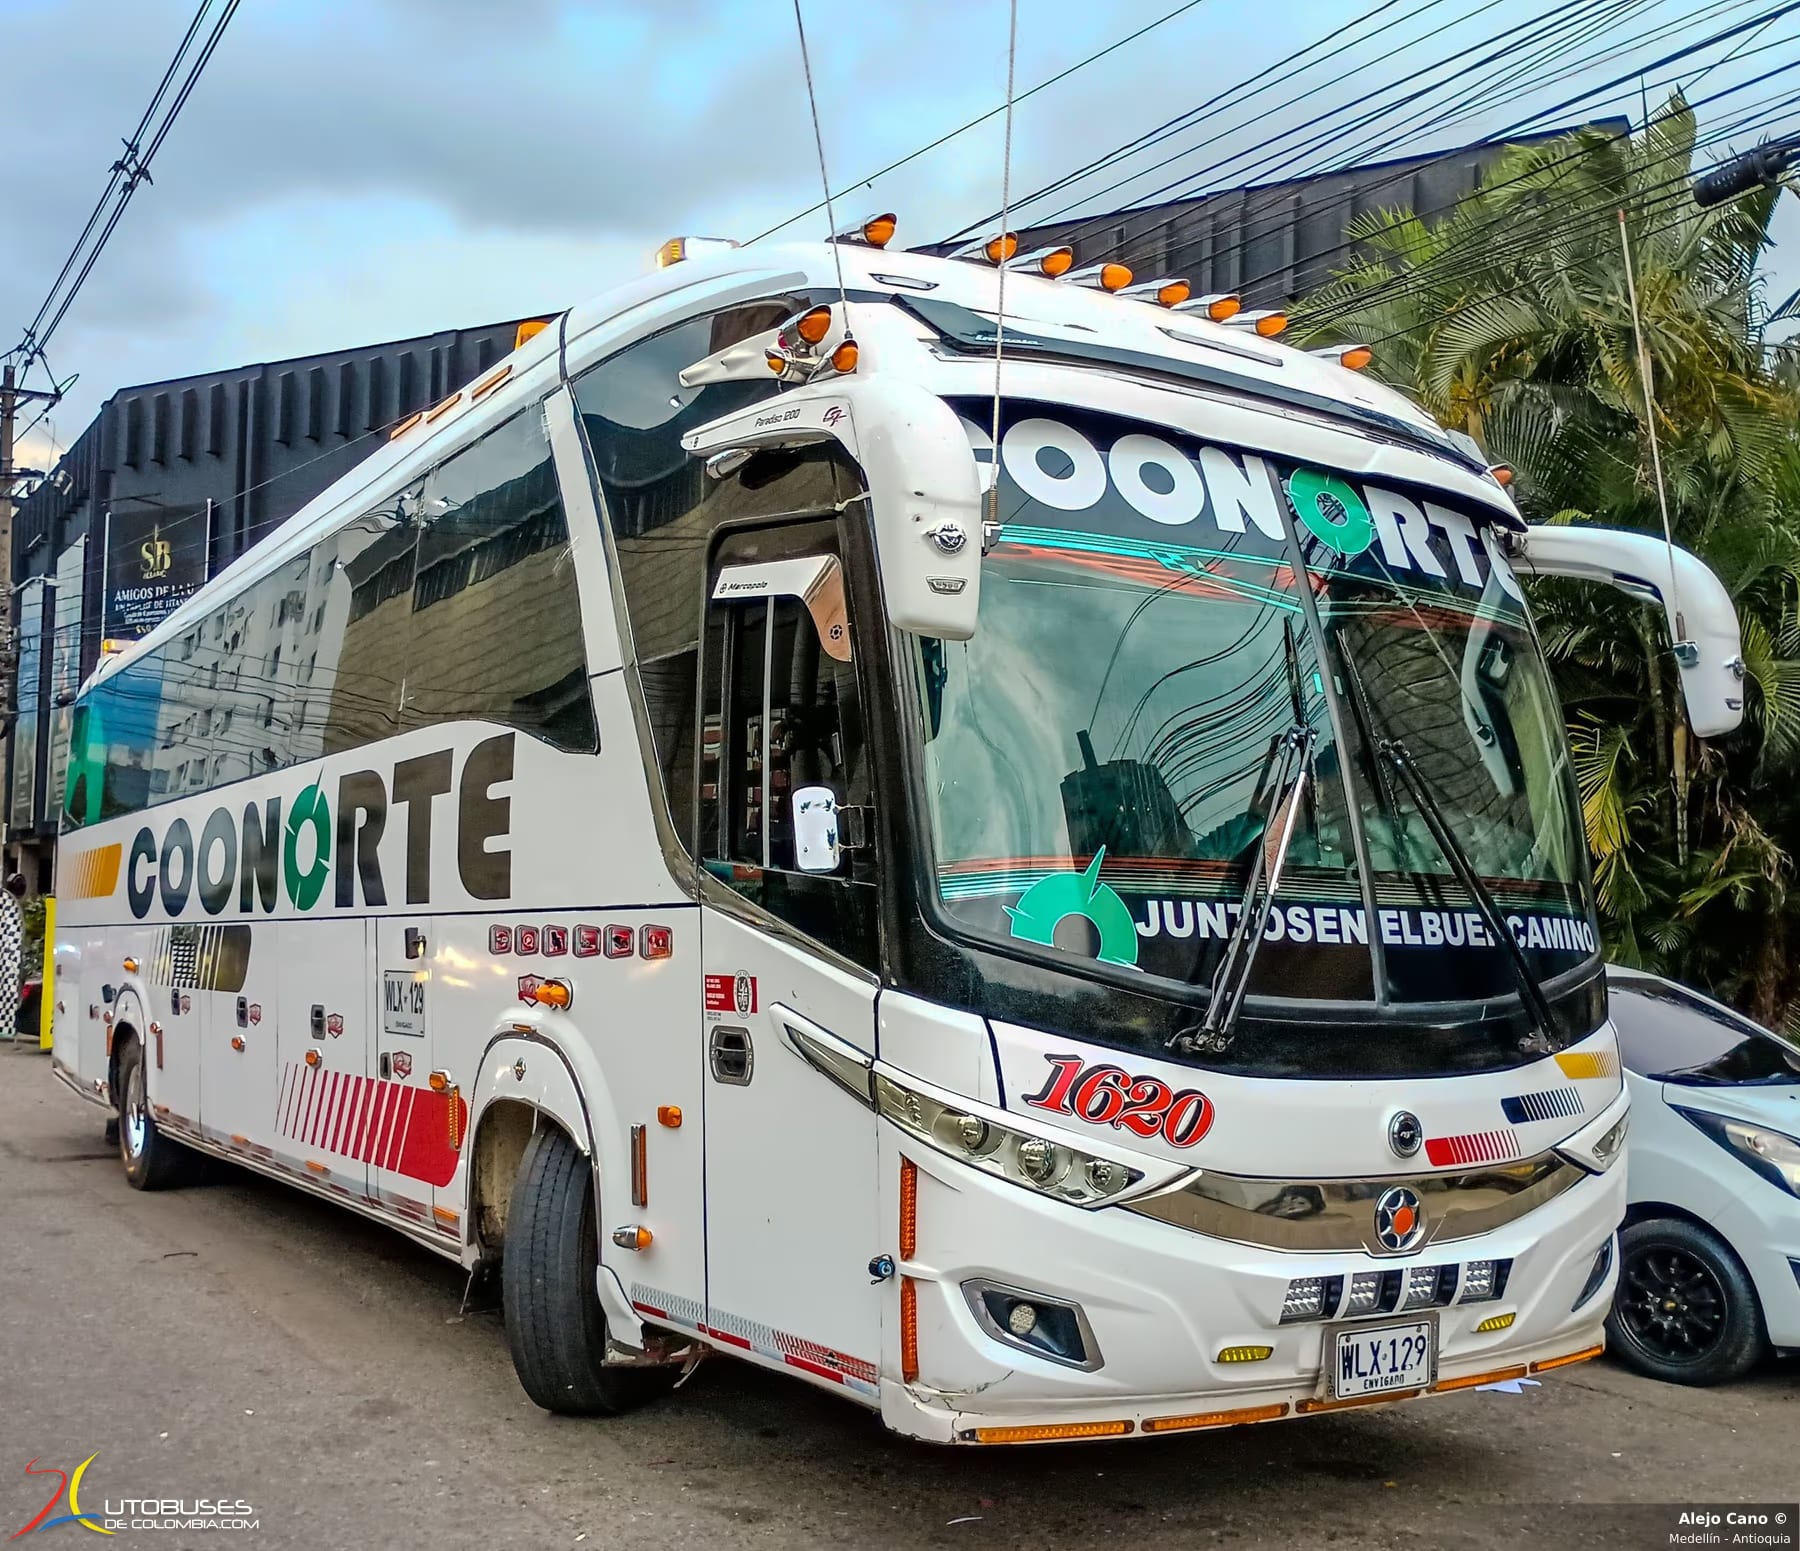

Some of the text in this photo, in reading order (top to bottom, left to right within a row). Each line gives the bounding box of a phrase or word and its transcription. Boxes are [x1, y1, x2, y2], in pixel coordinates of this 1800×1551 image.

[754, 414, 783, 428] Paradiso
[728, 581, 768, 591] Marcopolo
[114, 587, 154, 602] AMIGOS
[127, 732, 516, 920] COONORTE
[1021, 1053, 1216, 1149] 1620
